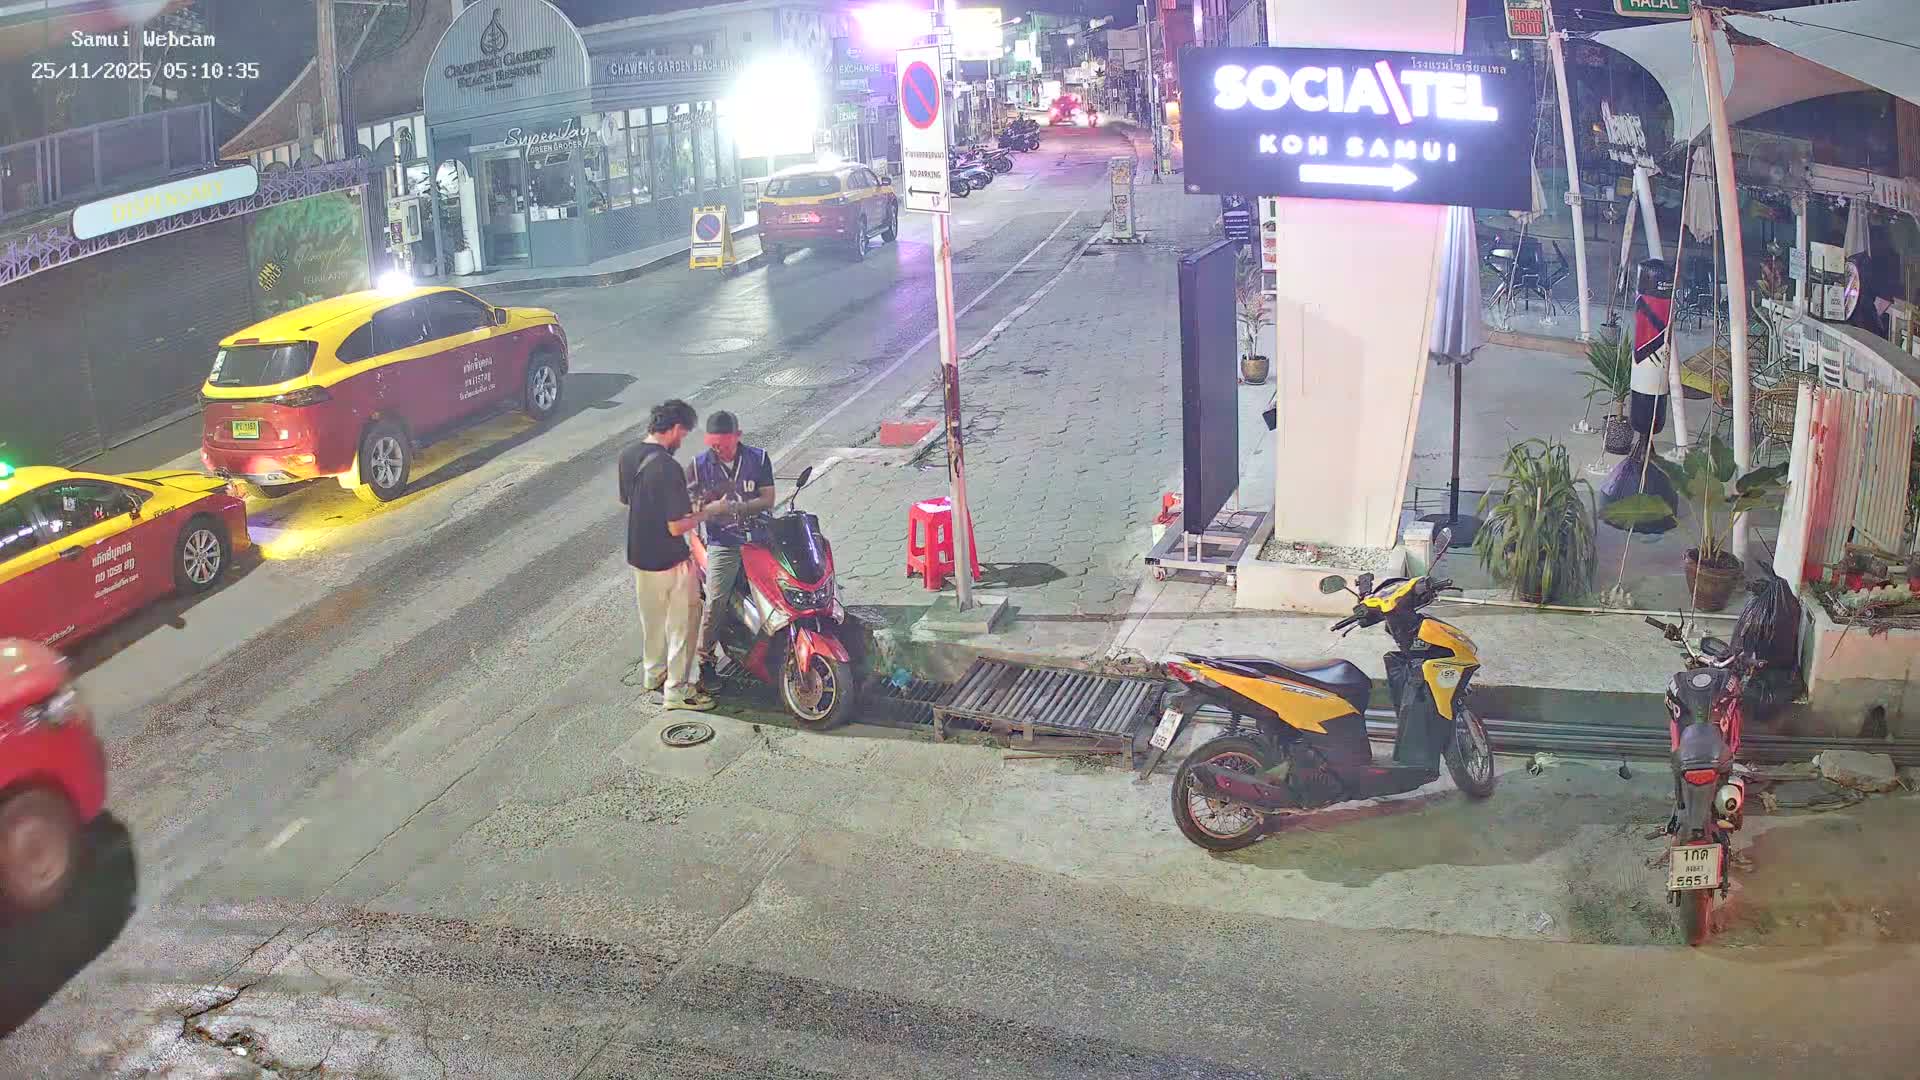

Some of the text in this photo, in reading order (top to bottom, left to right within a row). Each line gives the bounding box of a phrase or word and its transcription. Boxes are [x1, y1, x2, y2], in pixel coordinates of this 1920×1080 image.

[1510, 9, 1543, 20] INDIAN
[1513, 22, 1542, 34] FOOD
[611, 62, 655, 76] CHAWENG
[657, 60, 691, 73] GARDEN
[839, 63, 880, 74] EXCHANGE
[1259, 133, 1457, 162] KOH SAMUI
[910, 169, 941, 179] NO PARKING
[111, 178, 225, 224] DISPENSARY
